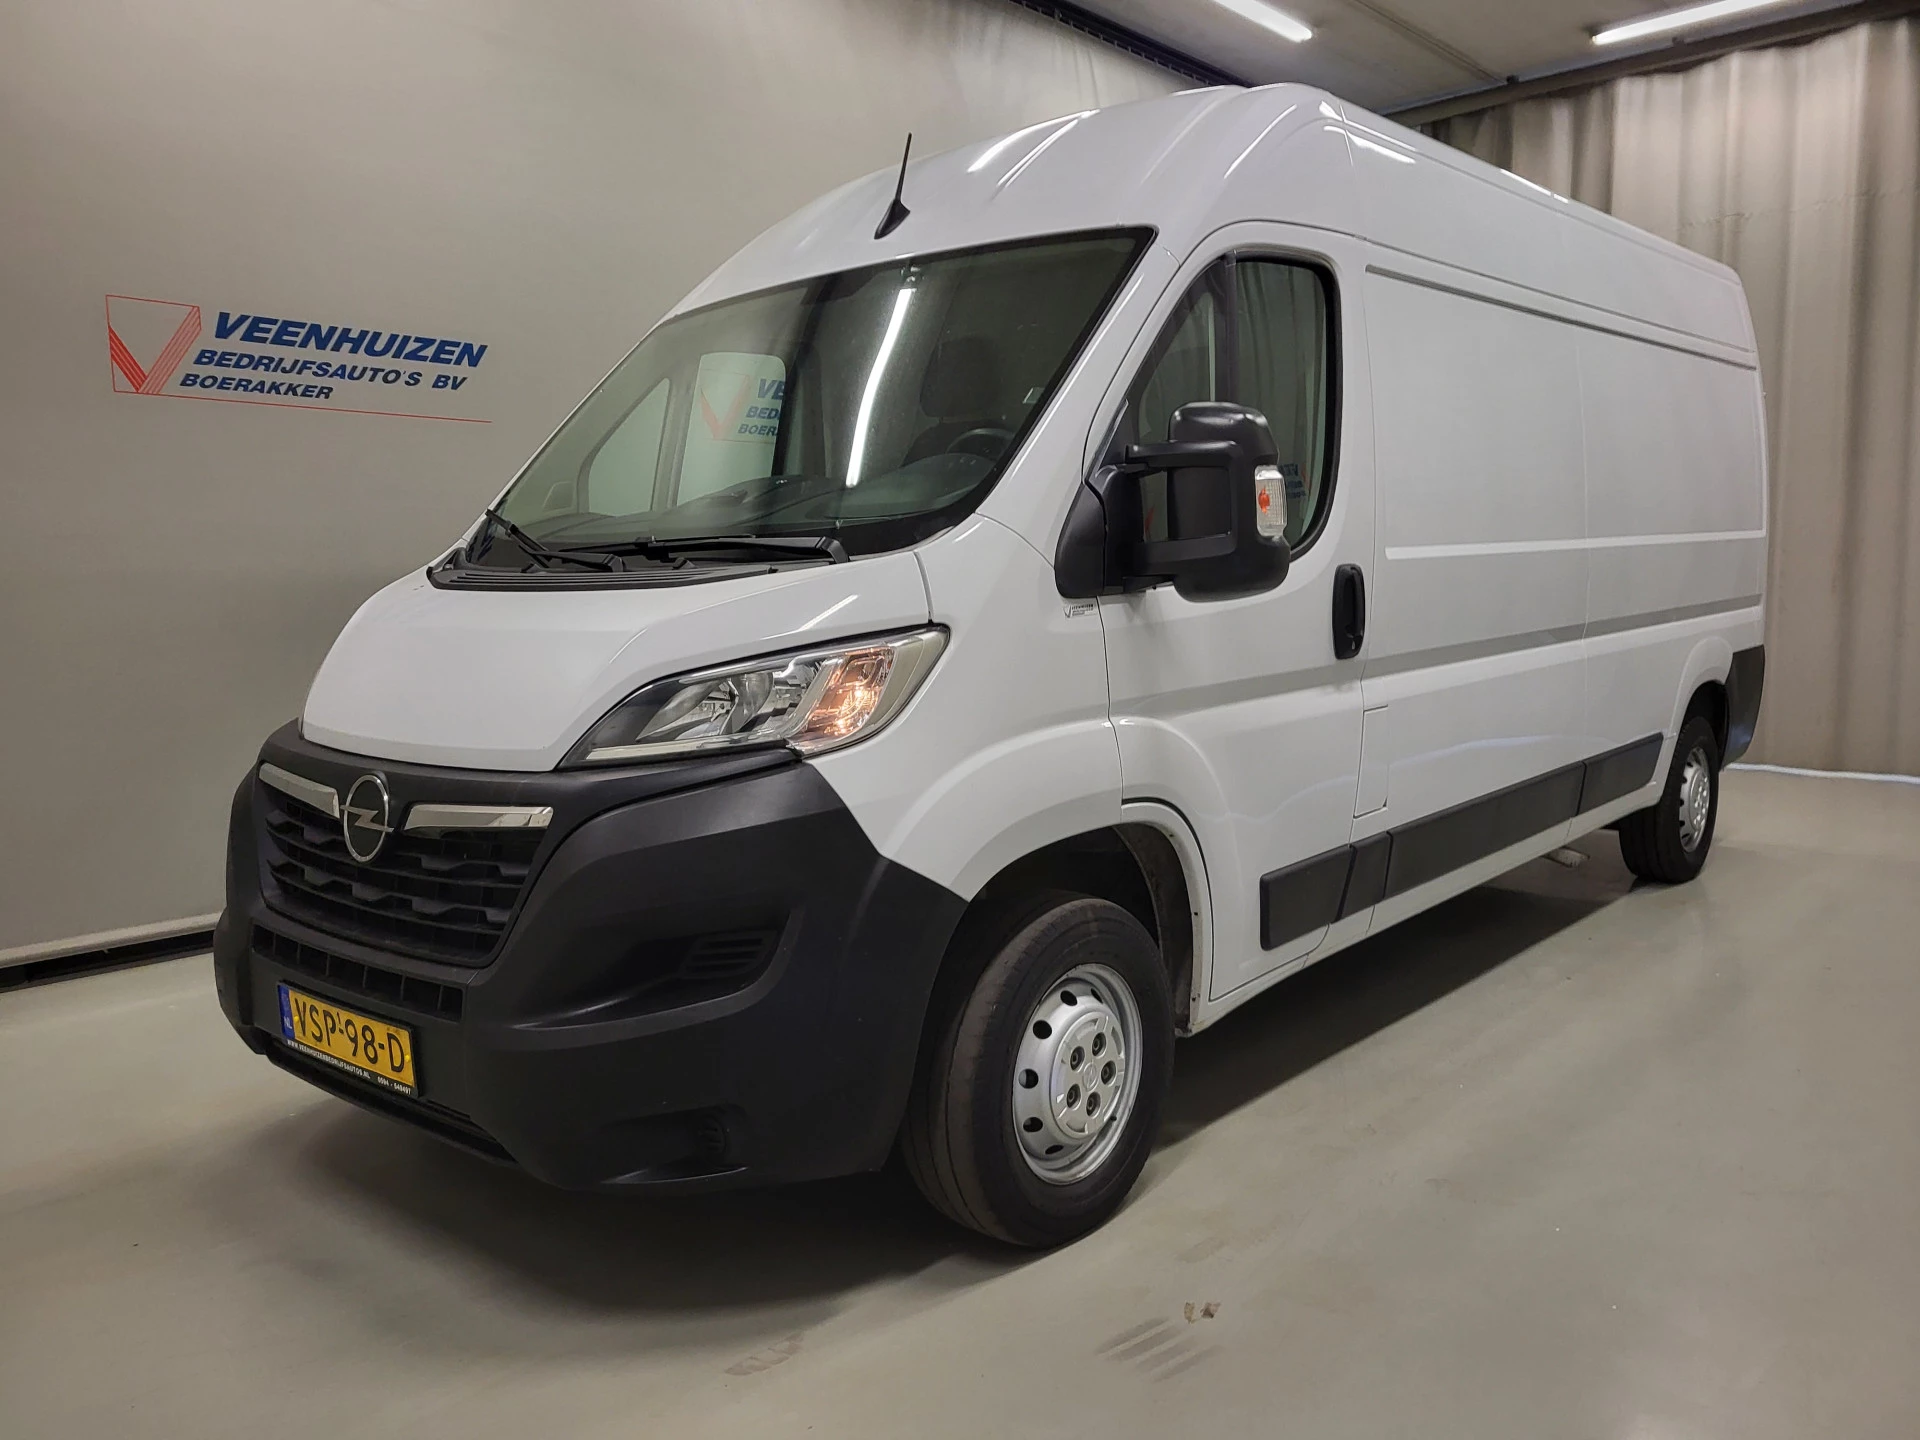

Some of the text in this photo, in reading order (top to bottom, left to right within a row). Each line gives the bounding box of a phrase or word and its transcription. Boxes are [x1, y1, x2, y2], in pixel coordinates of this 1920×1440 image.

[214, 311, 488, 367] VEENHUIZEN
[193, 349, 467, 391] BEDRIJFSAUTO'S BV
[180, 373, 333, 400] BOERAKKER
[746, 406, 782, 420] BED
[738, 424, 778, 436] BOER
[284, 1016, 293, 1029] NL
[294, 998, 405, 1073] VSP-98-D
